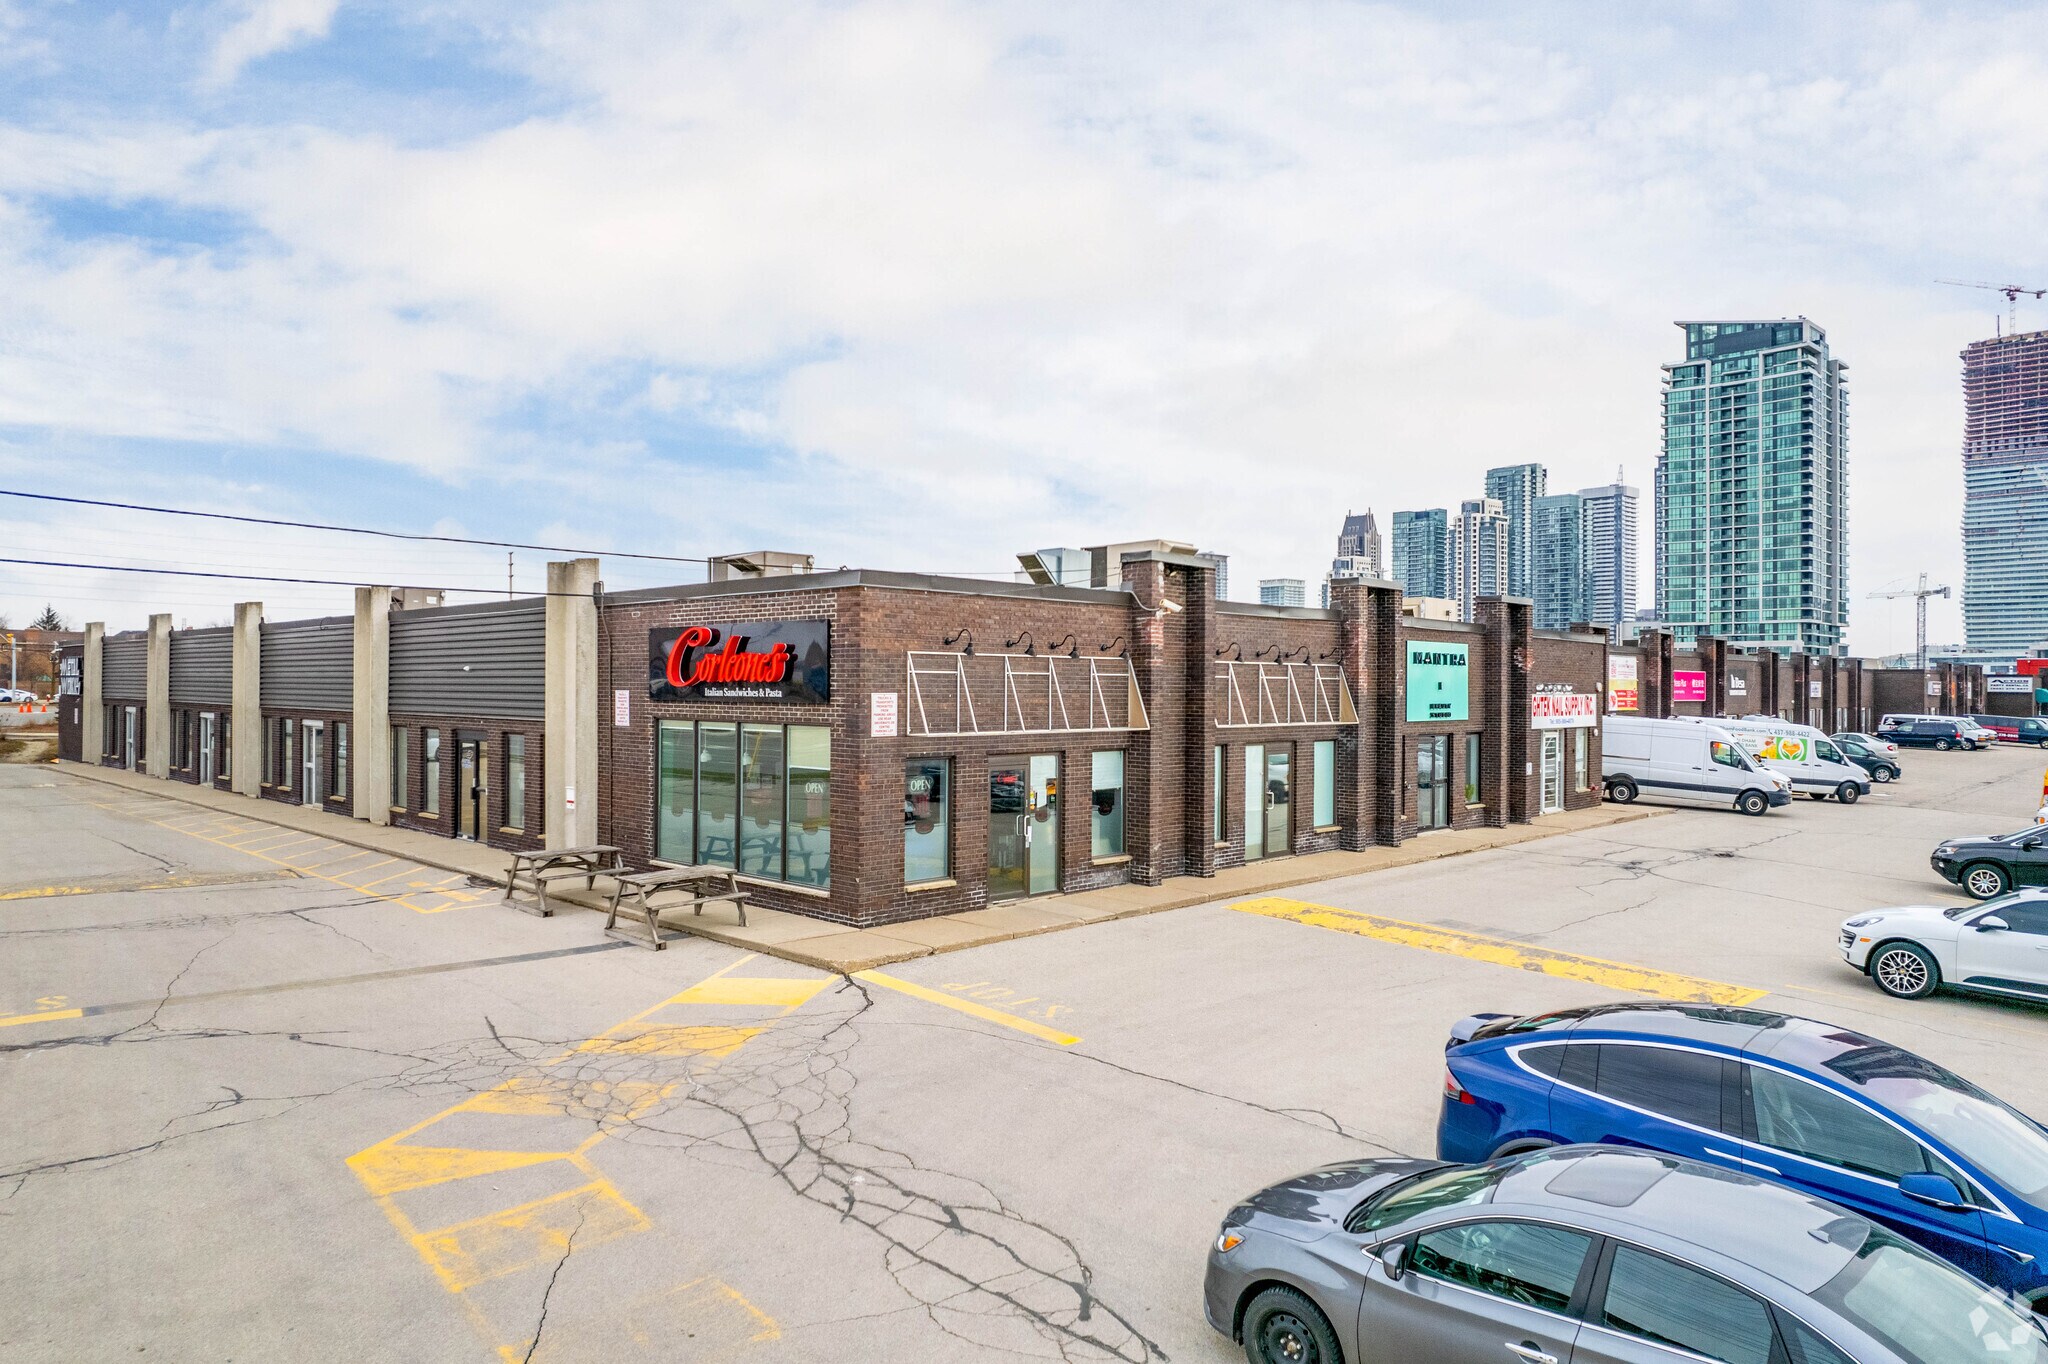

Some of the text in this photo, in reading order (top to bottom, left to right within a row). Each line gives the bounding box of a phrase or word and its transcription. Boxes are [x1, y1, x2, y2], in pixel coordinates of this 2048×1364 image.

[666, 626, 790, 687] Corleone's
[1412, 652, 1466, 666] MANTRA
[704, 687, 782, 698] Italian Sandwiches & Pasta
[1552, 697, 1563, 716] NAIL
[1565, 697, 1583, 716] SUPPLY
[805, 783, 823, 794] OPEN
[911, 780, 931, 791] OPEN
